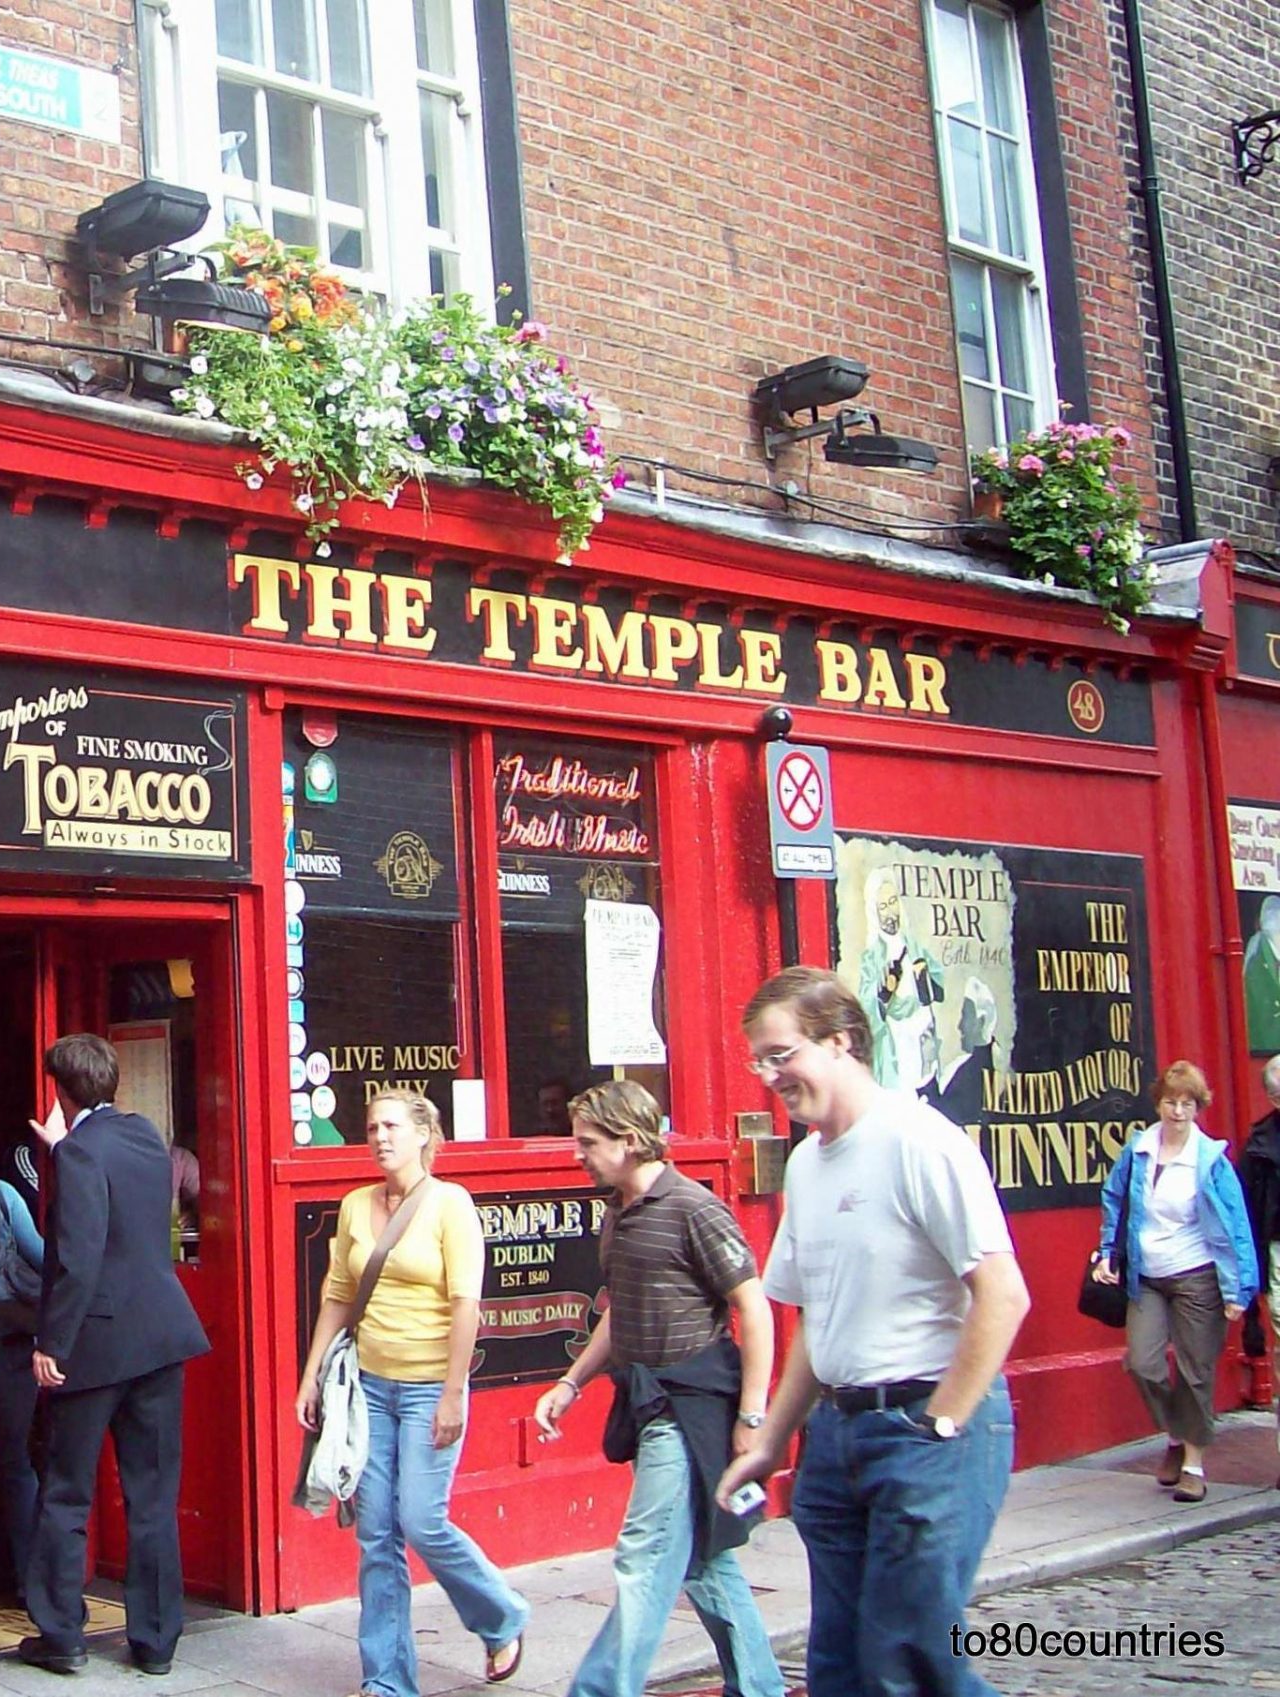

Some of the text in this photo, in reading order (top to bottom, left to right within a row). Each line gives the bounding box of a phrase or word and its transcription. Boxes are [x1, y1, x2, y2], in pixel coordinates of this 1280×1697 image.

[233, 553, 951, 715] THE TEMPLE BAR
[1074, 689, 1097, 720] 48
[44, 719, 67, 737] OF
[75, 734, 209, 766] FINE SMOKING
[3, 742, 211, 835] TOBACCO
[500, 754, 641, 802] Traditional
[50, 821, 227, 852] Always in Stock
[501, 805, 650, 854] Irish Music
[295, 853, 342, 876] INNESS
[497, 869, 550, 895] GUINNESS
[893, 863, 1008, 903] TEMPLE
[931, 903, 986, 943] BAR
[1085, 901, 1128, 945] THE
[1036, 949, 1133, 996] EMPEROR
[1108, 1002, 1133, 1044] OF
[329, 1045, 461, 1073] LIVE MUSIC
[981, 1047, 1144, 1116] MALTED LIQUORS
[475, 1200, 584, 1243] EMPLE
[491, 1242, 556, 1267] DUBLIN
[500, 1270, 550, 1288] EST. 1840
[479, 1302, 585, 1327] VE MUSIC DAILY
